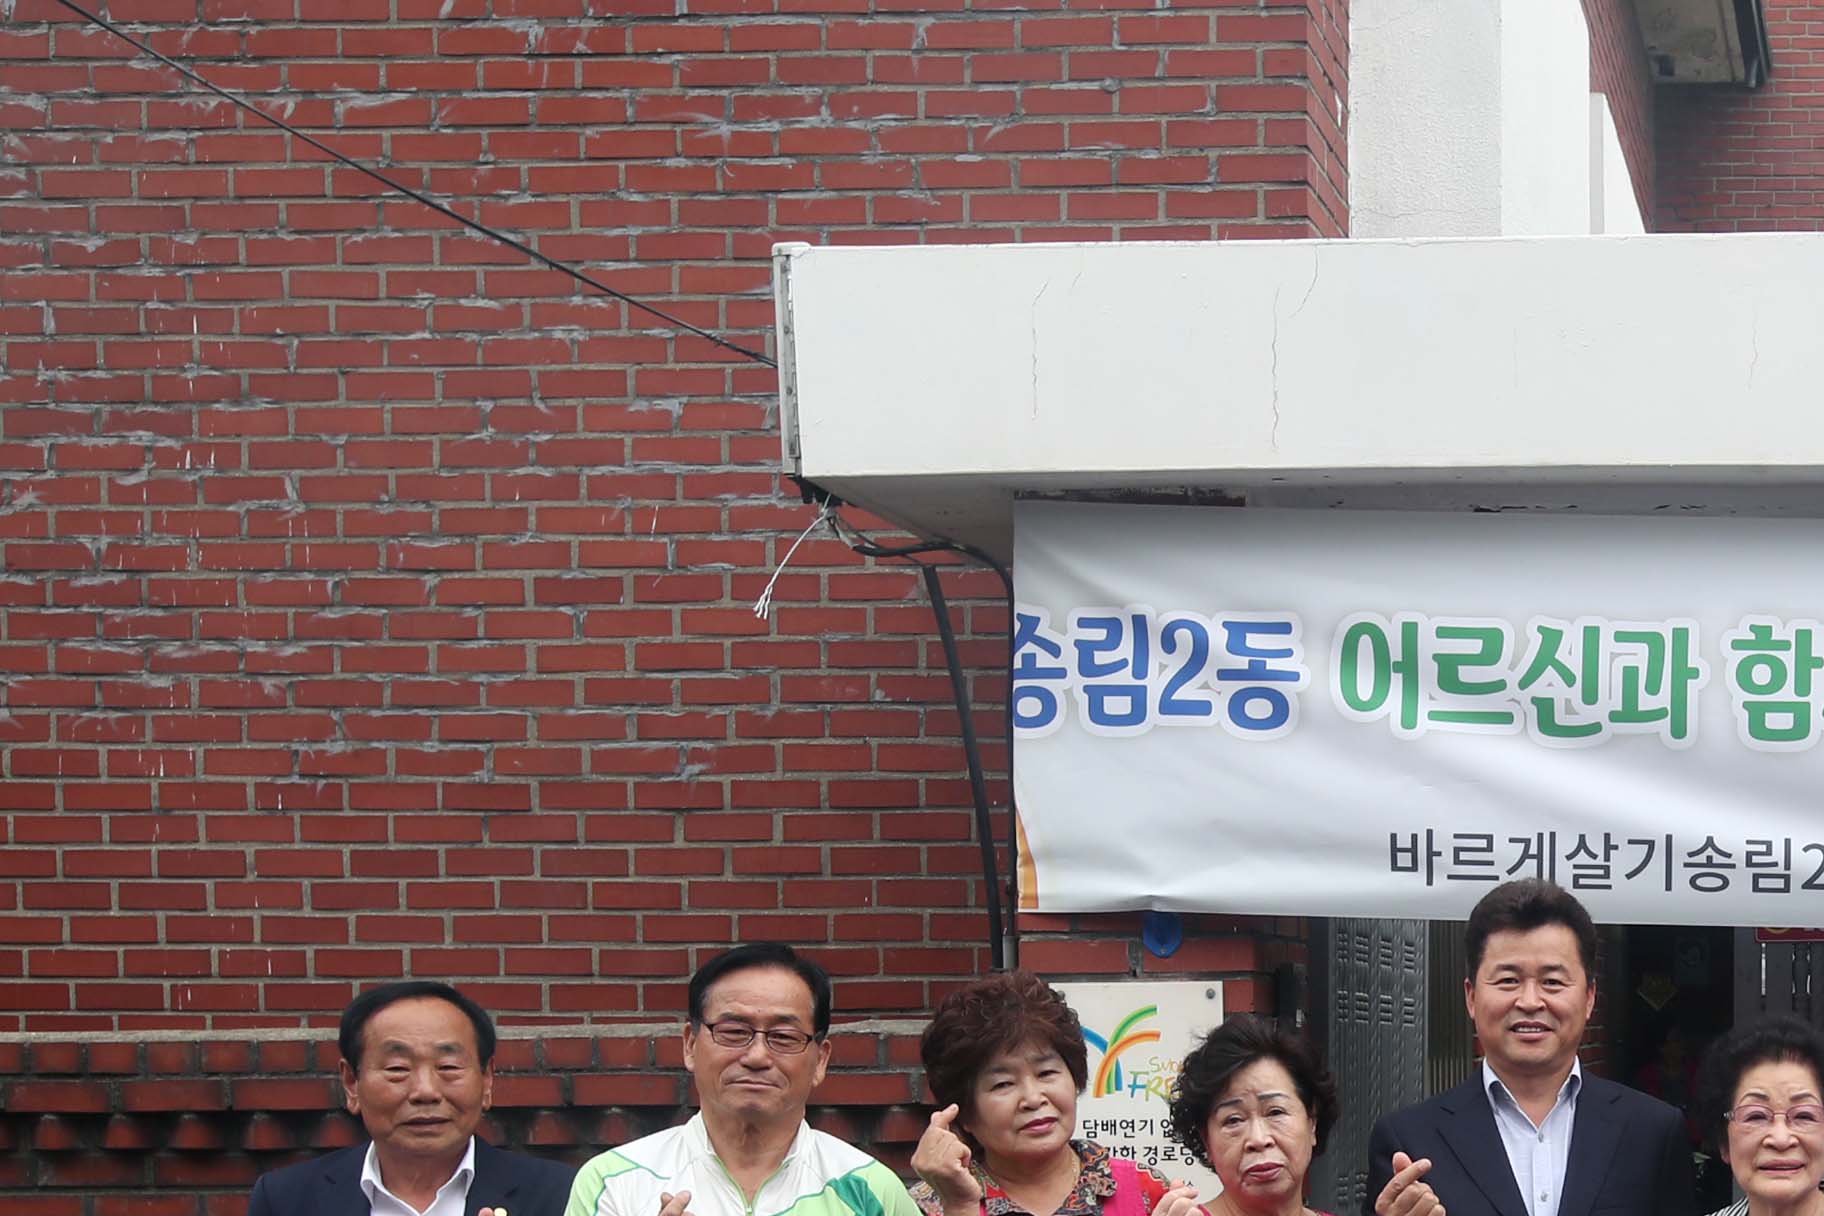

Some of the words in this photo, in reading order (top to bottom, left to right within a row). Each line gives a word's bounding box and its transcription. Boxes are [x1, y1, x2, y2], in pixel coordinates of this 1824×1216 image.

[1012, 611, 1302, 732] 송림2동
[1338, 620, 1701, 740] 어르신과
[1082, 1118, 1154, 1139] 담배연기
